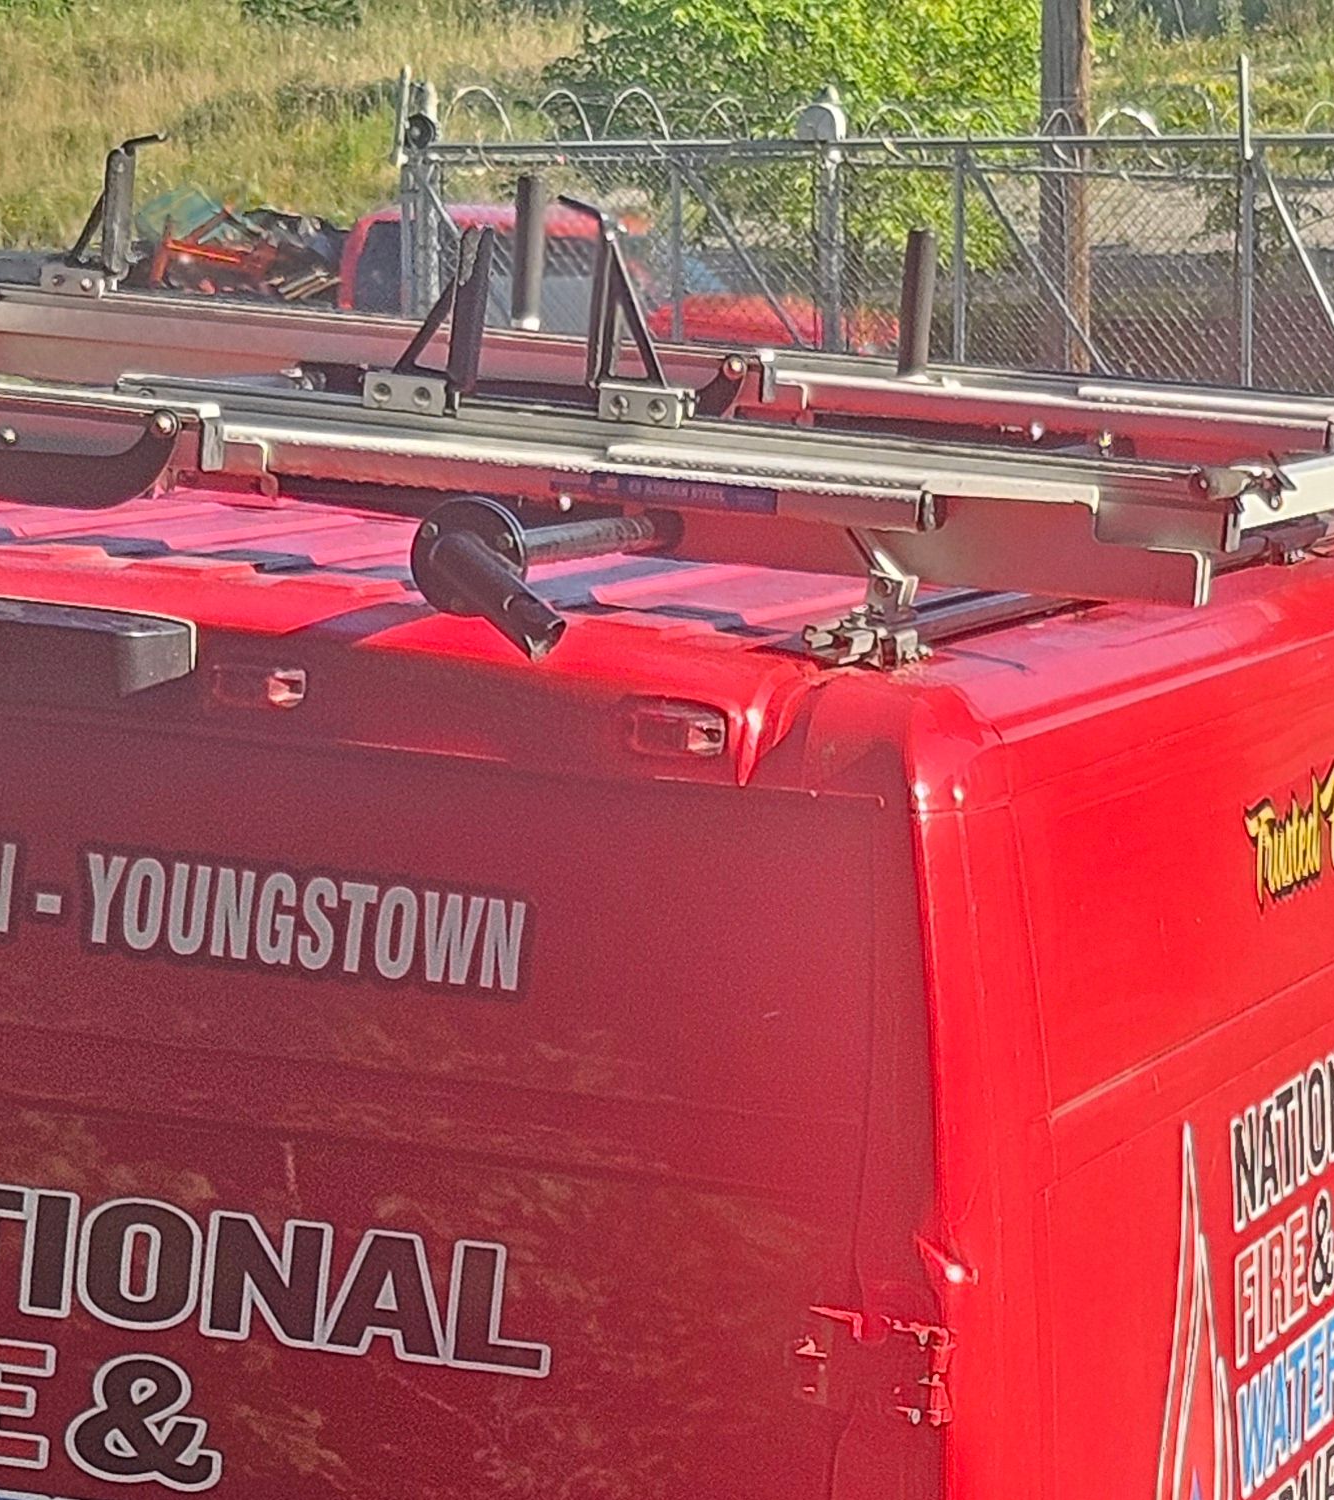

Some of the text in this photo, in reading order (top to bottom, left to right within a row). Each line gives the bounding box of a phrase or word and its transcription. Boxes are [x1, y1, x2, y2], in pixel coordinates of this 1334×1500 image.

[1244, 774, 1322, 904] Trusted
[83, 852, 527, 991] YOUNGSTOWN
[1233, 1204, 1312, 1370] FIRE
[65, 1352, 223, 1492] &
